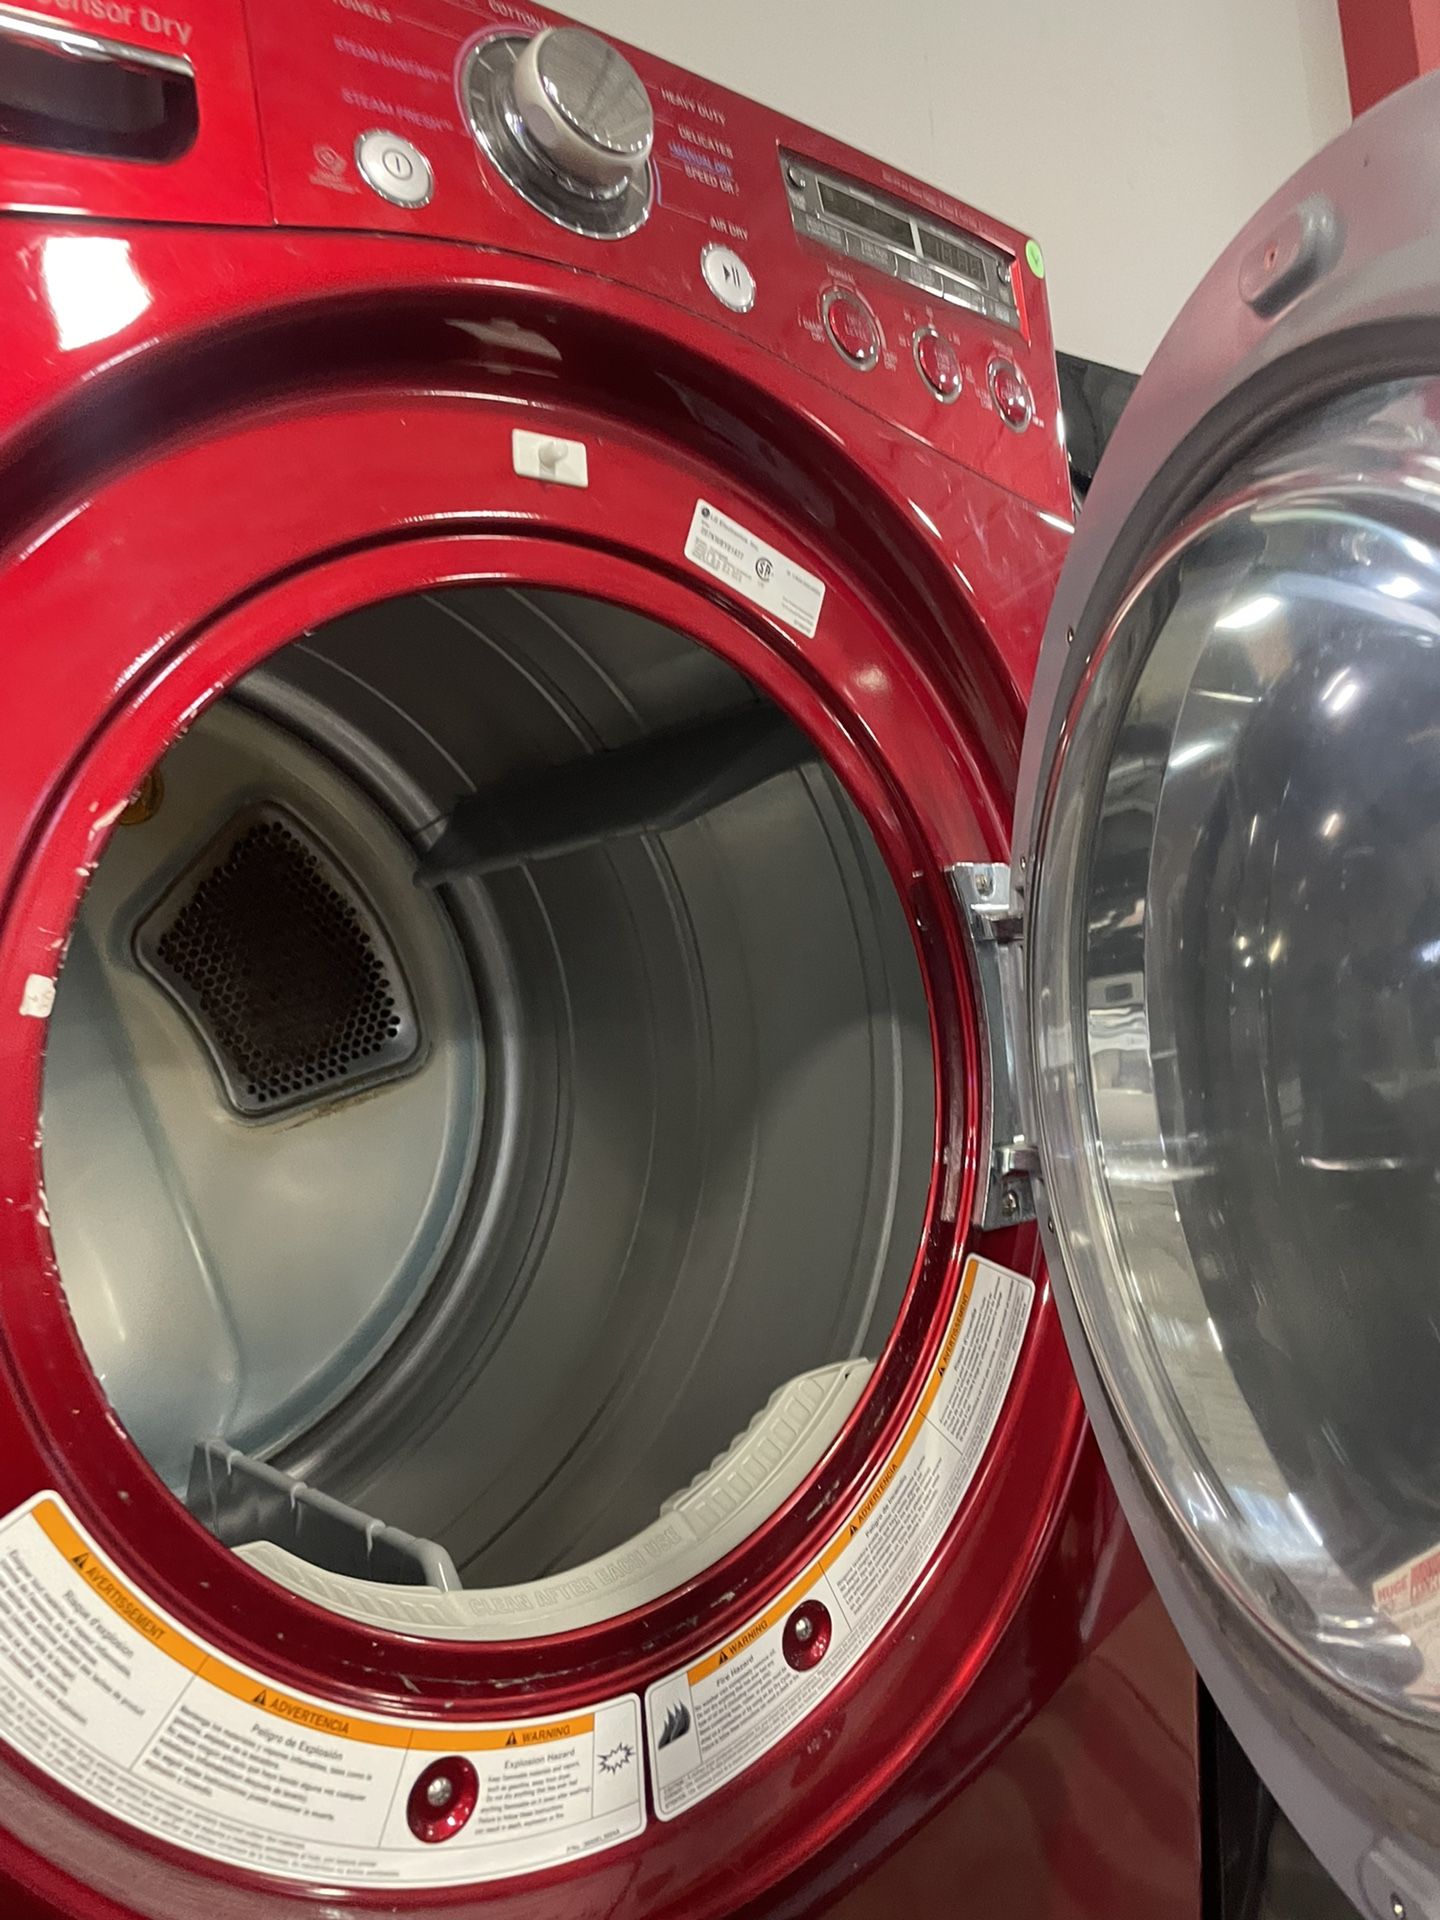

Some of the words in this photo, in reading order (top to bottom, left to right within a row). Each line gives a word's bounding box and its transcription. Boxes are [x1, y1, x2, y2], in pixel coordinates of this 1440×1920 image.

[140, 8, 192, 46] Dry
[660, 87, 696, 112] HEAVY
[697, 99, 726, 126] DUTY
[677, 125, 734, 159] DELICATES
[709, 215, 729, 233] AIR
[729, 220, 749, 241] DRY
[469, 1592, 535, 1617] CLEAN
[534, 1578, 594, 1608] AFTER
[600, 1554, 648, 1585] EACH
[651, 1526, 682, 1559] USE
[86, 1567, 165, 1640] AVERTISSEMENT
[729, 1620, 769, 1655] WARNING
[271, 1698, 349, 1734] ADVERTENCIA
[252, 1723, 284, 1745] Peligro
[285, 1735, 297, 1749] de
[522, 1725, 570, 1744] WARNING
[504, 1756, 545, 1771] Explosion
[547, 1748, 575, 1763] Hazard
